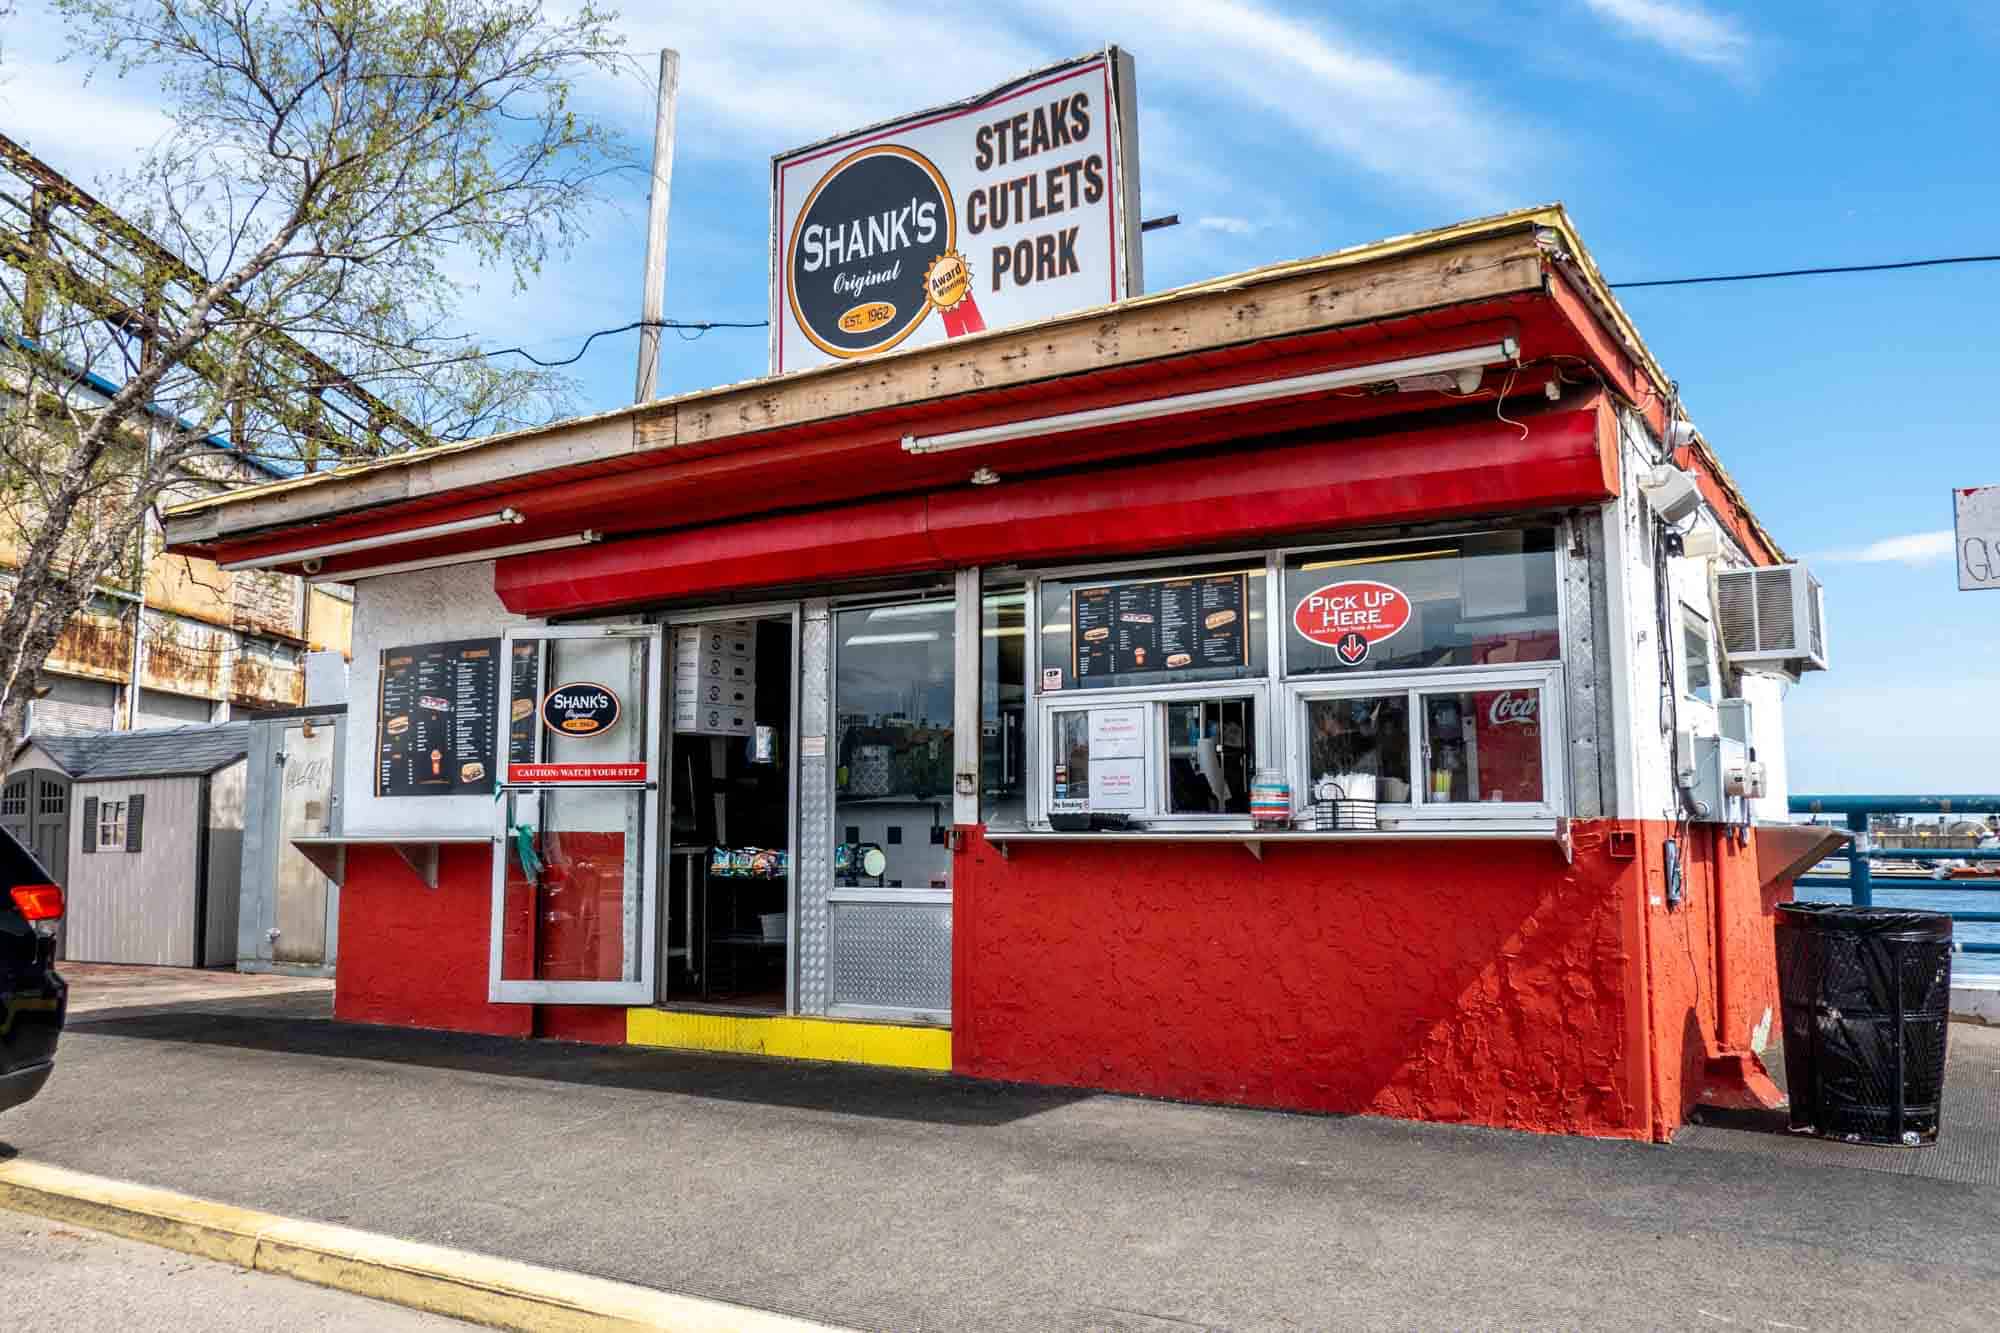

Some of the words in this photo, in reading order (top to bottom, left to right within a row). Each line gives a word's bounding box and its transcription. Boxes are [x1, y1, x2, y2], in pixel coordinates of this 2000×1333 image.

[975, 92, 1091, 172] STEAKS
[966, 154, 1104, 235] CUTLETS
[803, 197, 937, 272] SHANK'S
[991, 226, 1080, 292] PORK
[833, 260, 901, 297] Original
[932, 262, 962, 290] Award
[937, 276, 965, 297] Winning
[867, 305, 889, 322] 1962
[1308, 595, 1359, 613] PICK
[1363, 591, 1395, 608] UP
[1322, 609, 1382, 626] HERE
[554, 692, 609, 709] SHANK'S
[517, 768, 559, 777] CAUTION:
[560, 768, 591, 777] WATCH
[592, 767, 617, 776] YOUR
[618, 767, 640, 776] STEP
